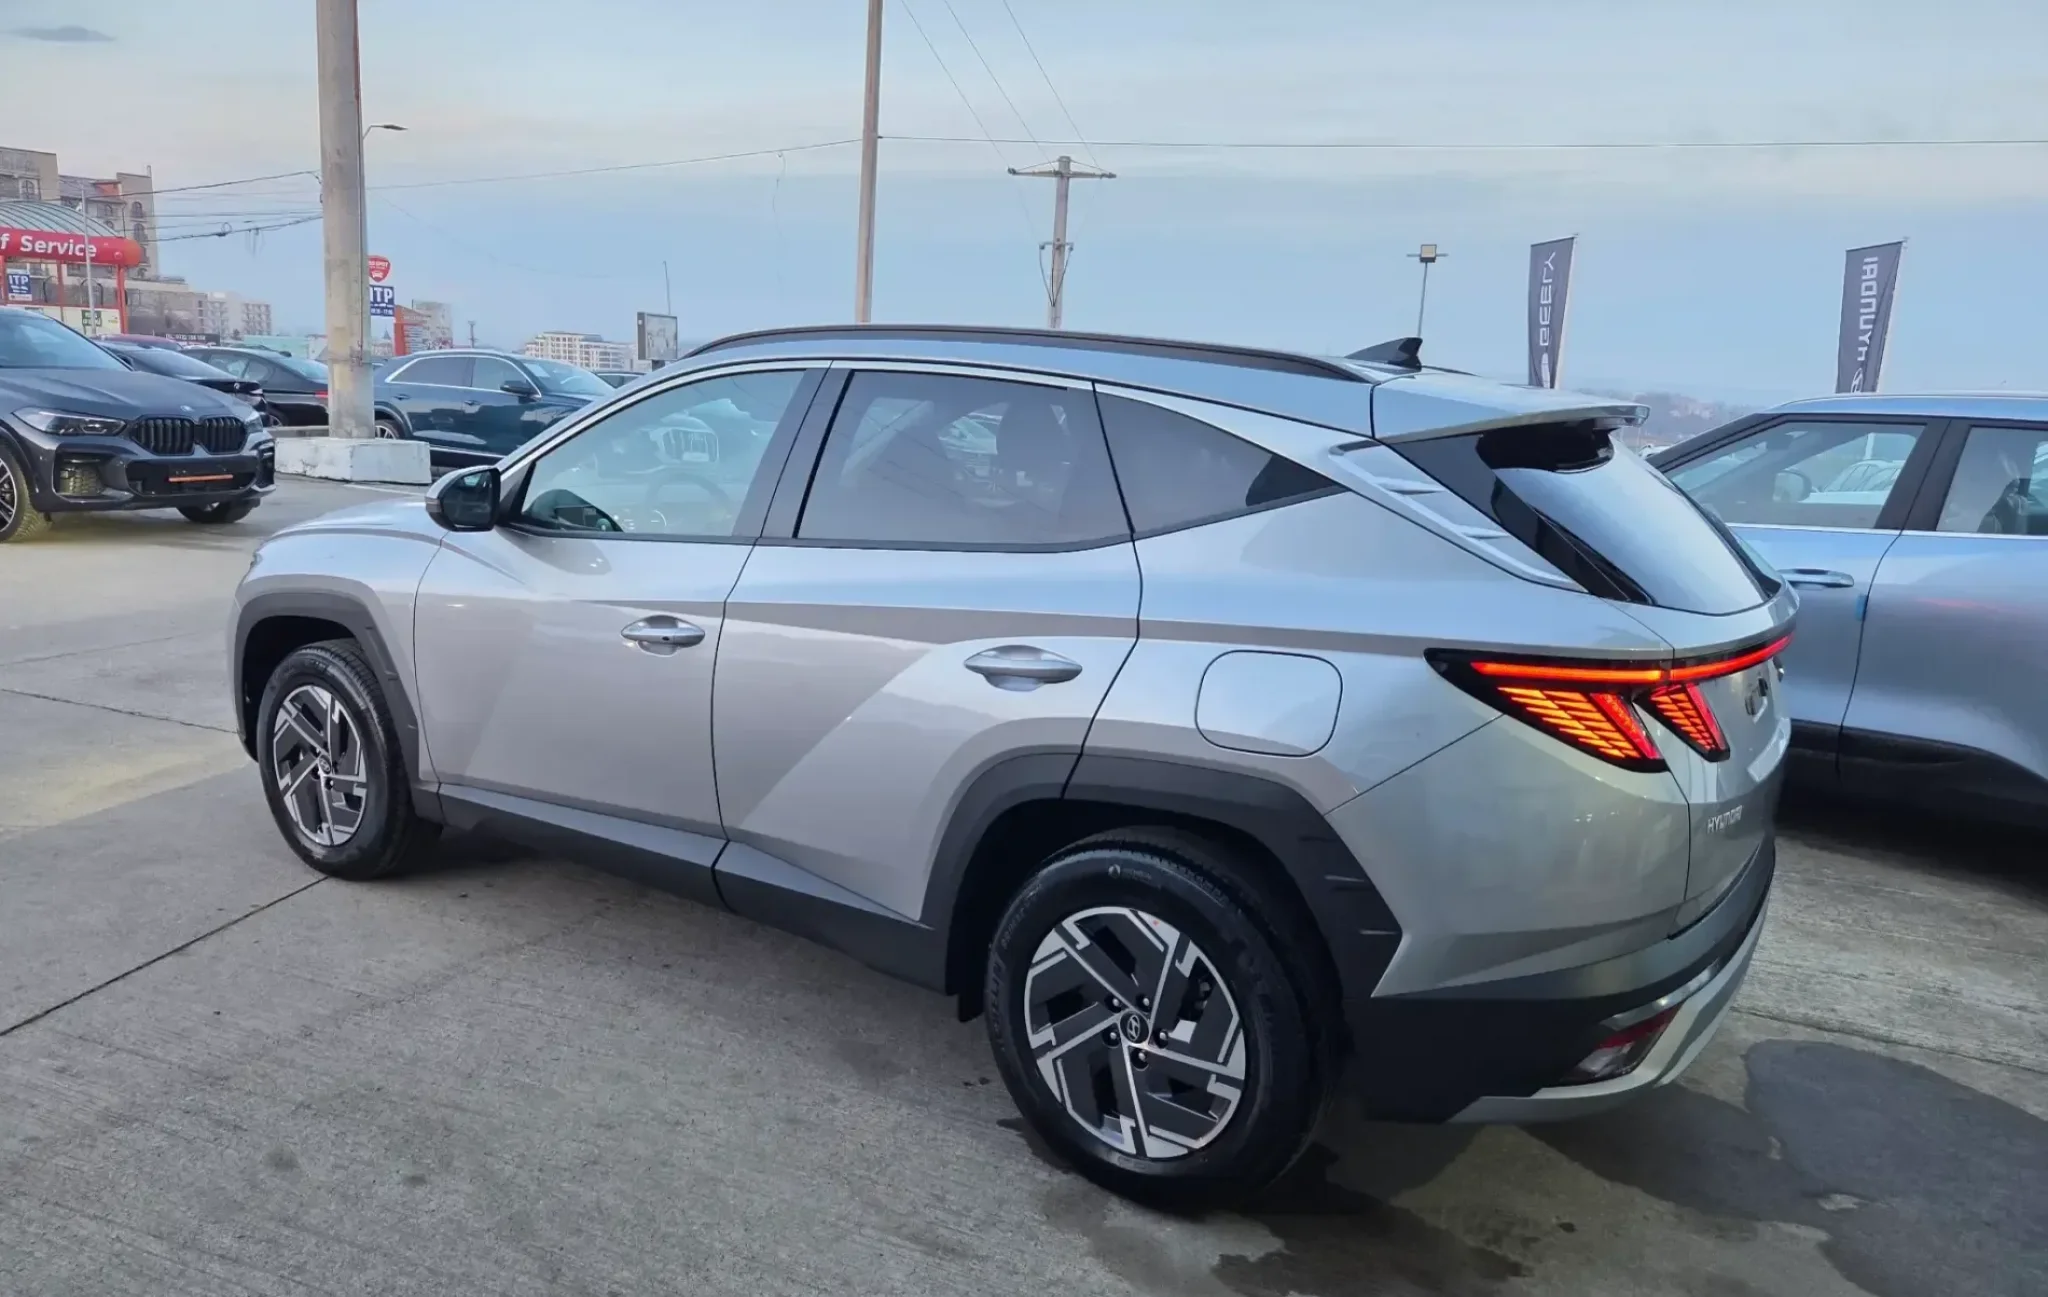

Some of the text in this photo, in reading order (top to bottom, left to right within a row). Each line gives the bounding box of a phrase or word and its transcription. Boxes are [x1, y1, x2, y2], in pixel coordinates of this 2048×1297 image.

[20, 235, 97, 258] Service
[9, 275, 29, 285] ITP
[370, 286, 392, 302] ITP
